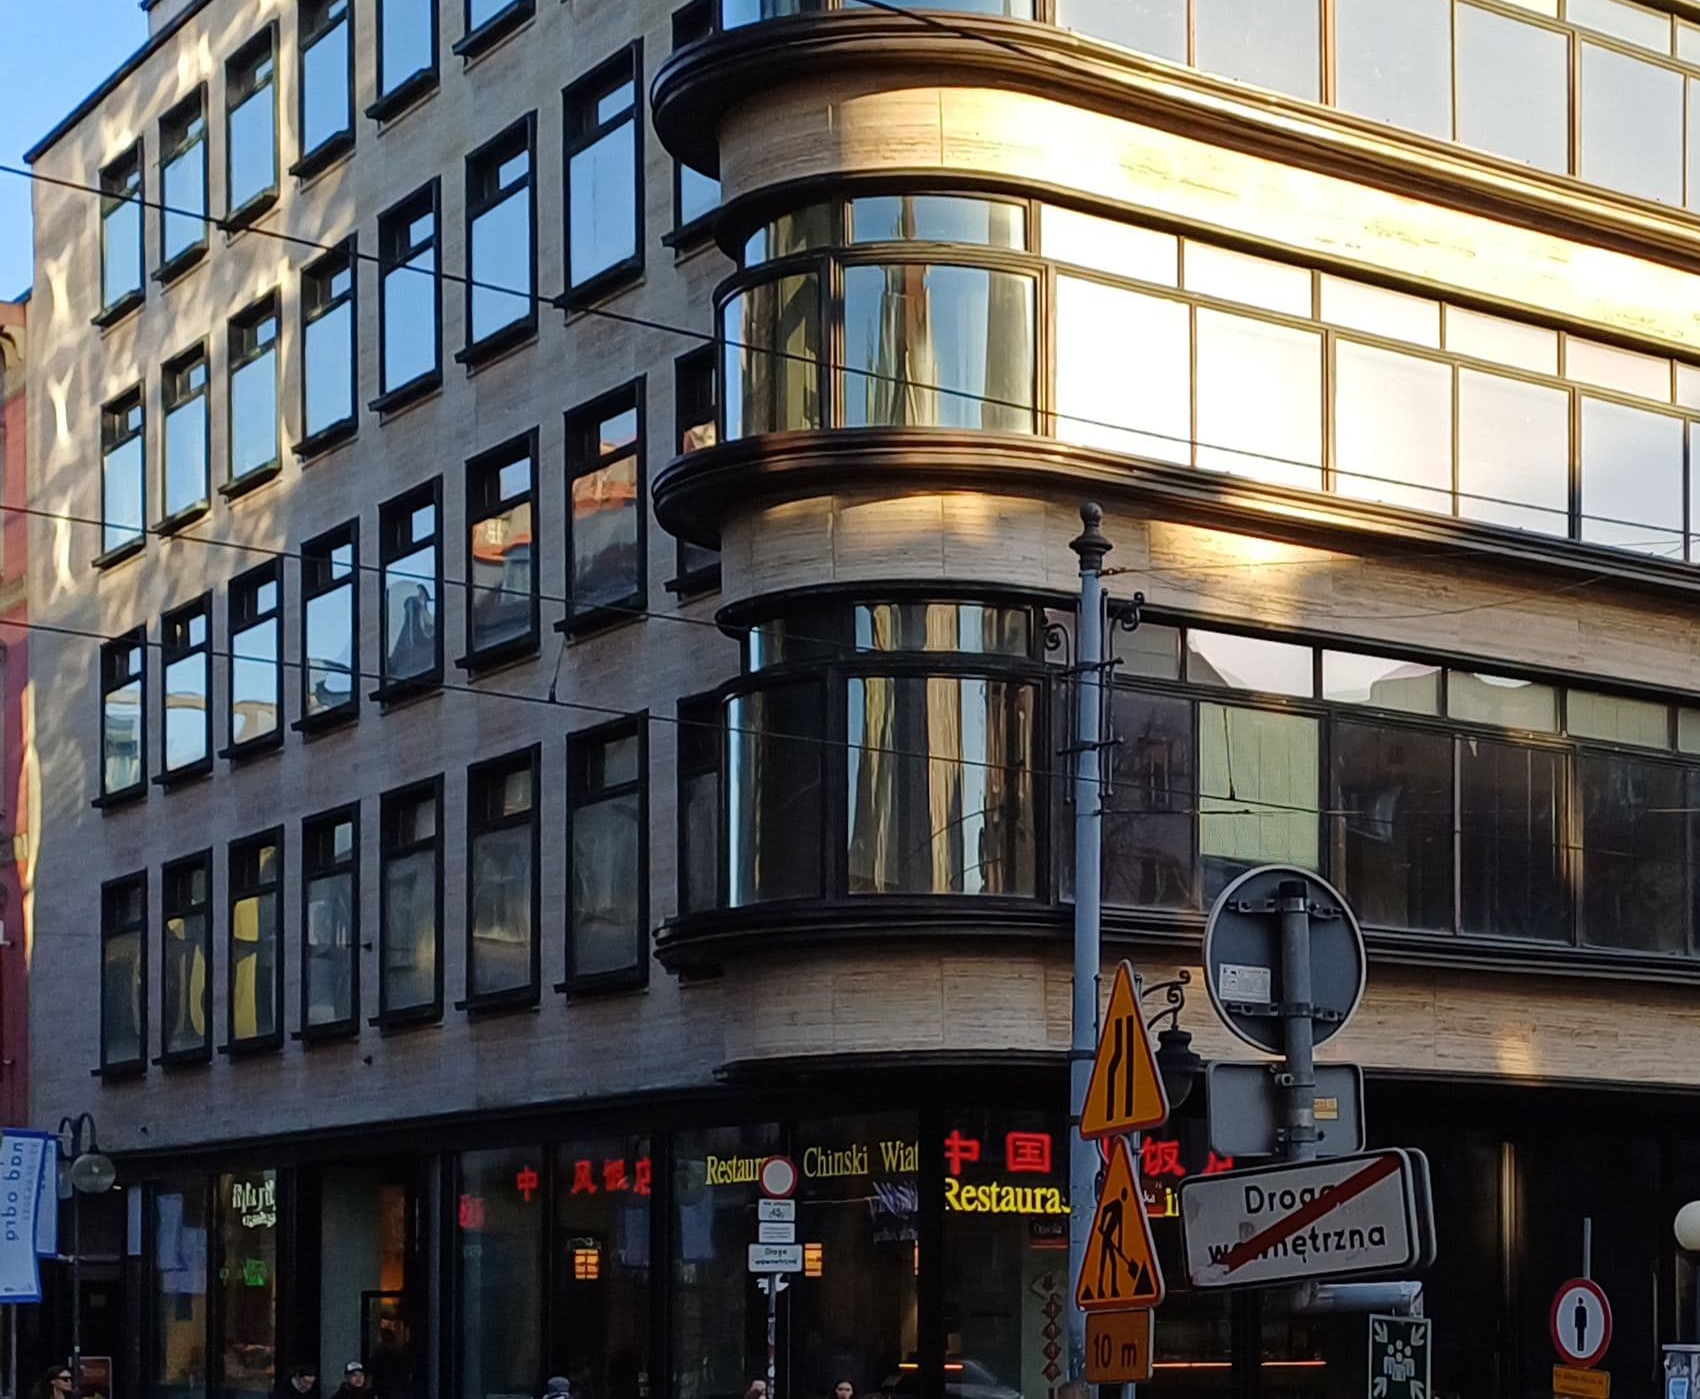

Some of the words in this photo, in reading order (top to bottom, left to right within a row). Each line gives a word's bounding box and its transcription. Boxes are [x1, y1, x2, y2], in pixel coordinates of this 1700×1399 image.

[705, 1155, 769, 1185] Restaur
[944, 1177, 1071, 1214] Restaura
[1207, 1225, 1386, 1265] wnętrzna
[1094, 1333, 1111, 1368] 10
[1121, 1342, 1137, 1367] m
